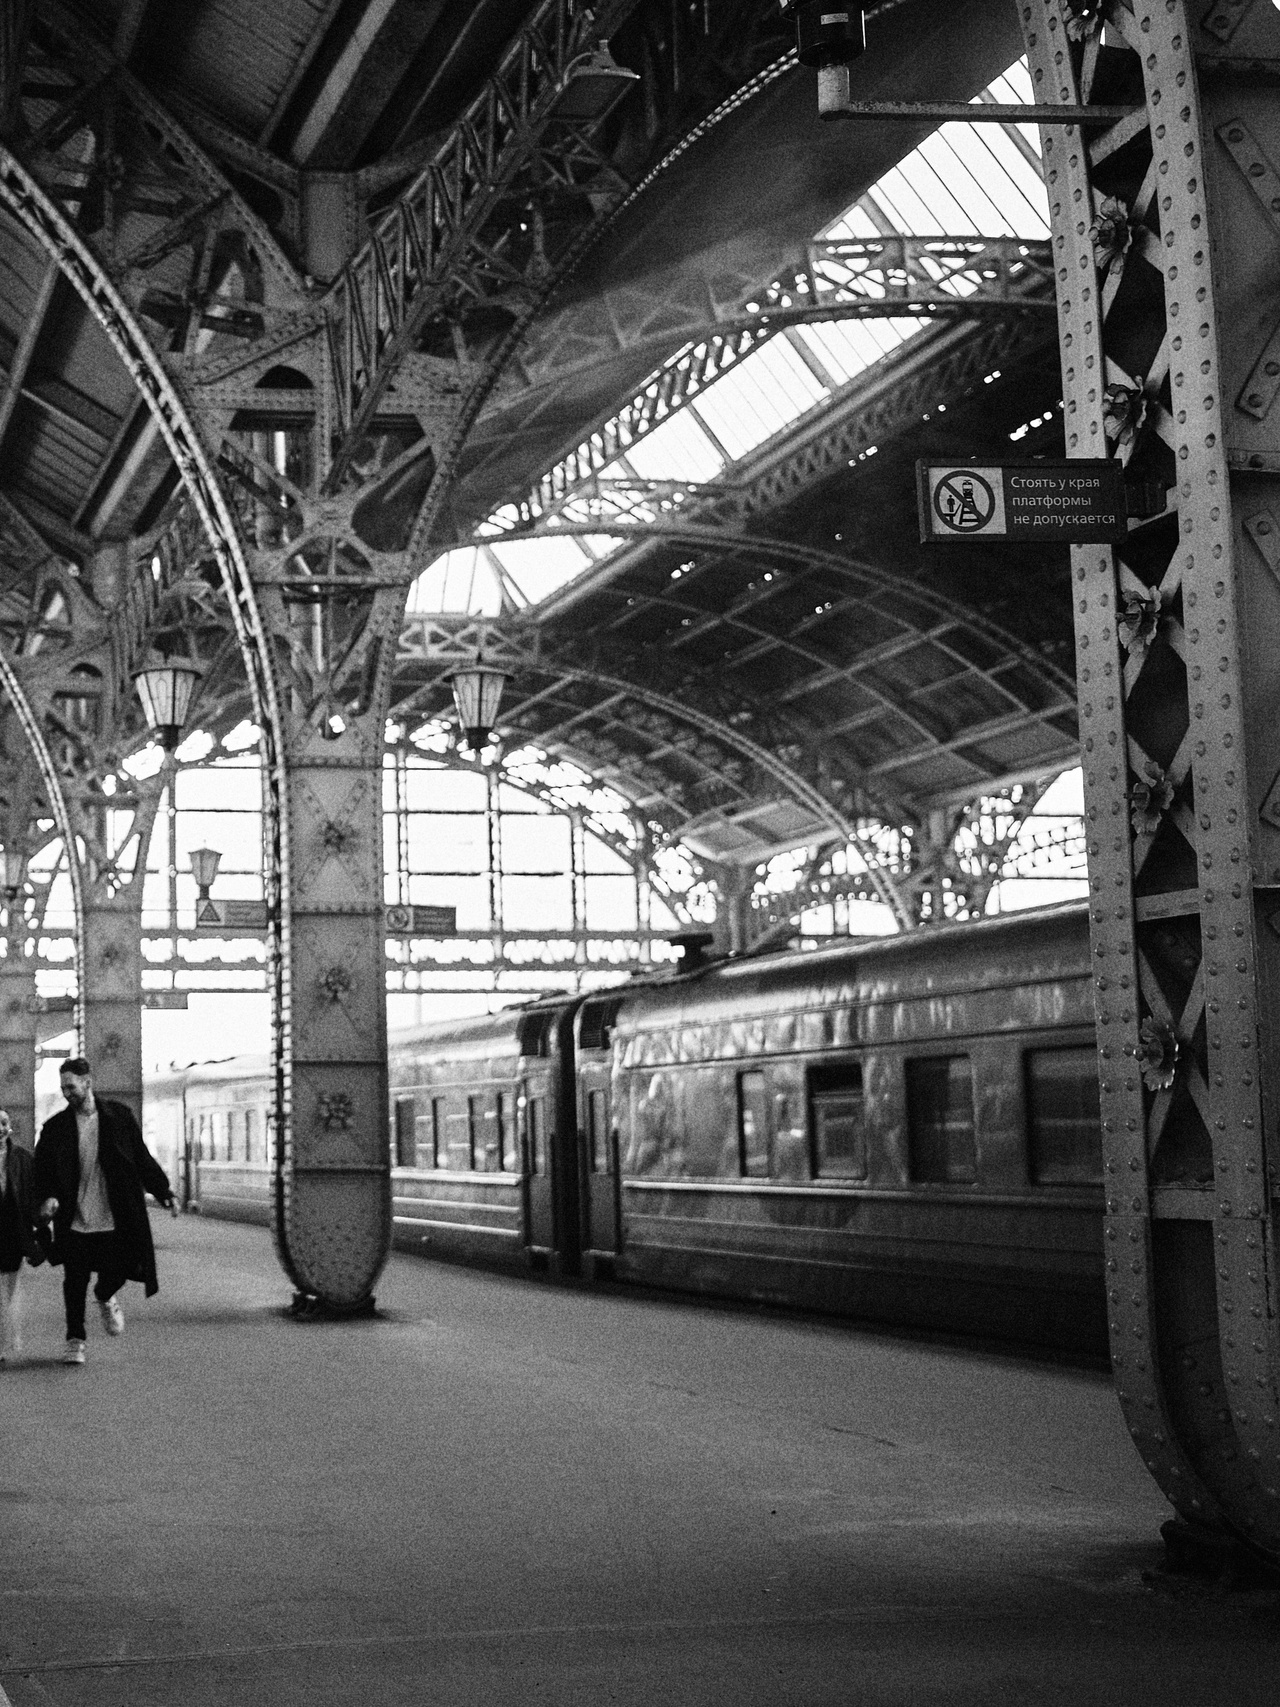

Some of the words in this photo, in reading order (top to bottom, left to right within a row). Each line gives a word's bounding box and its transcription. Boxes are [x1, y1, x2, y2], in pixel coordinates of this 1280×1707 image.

[1010, 476, 1057, 489] Стоять
[1058, 478, 1067, 490] у
[1069, 477, 1100, 490] края
[1012, 494, 1092, 509] платформы
[1013, 514, 1030, 524] не
[1033, 513, 1116, 527] допускается
